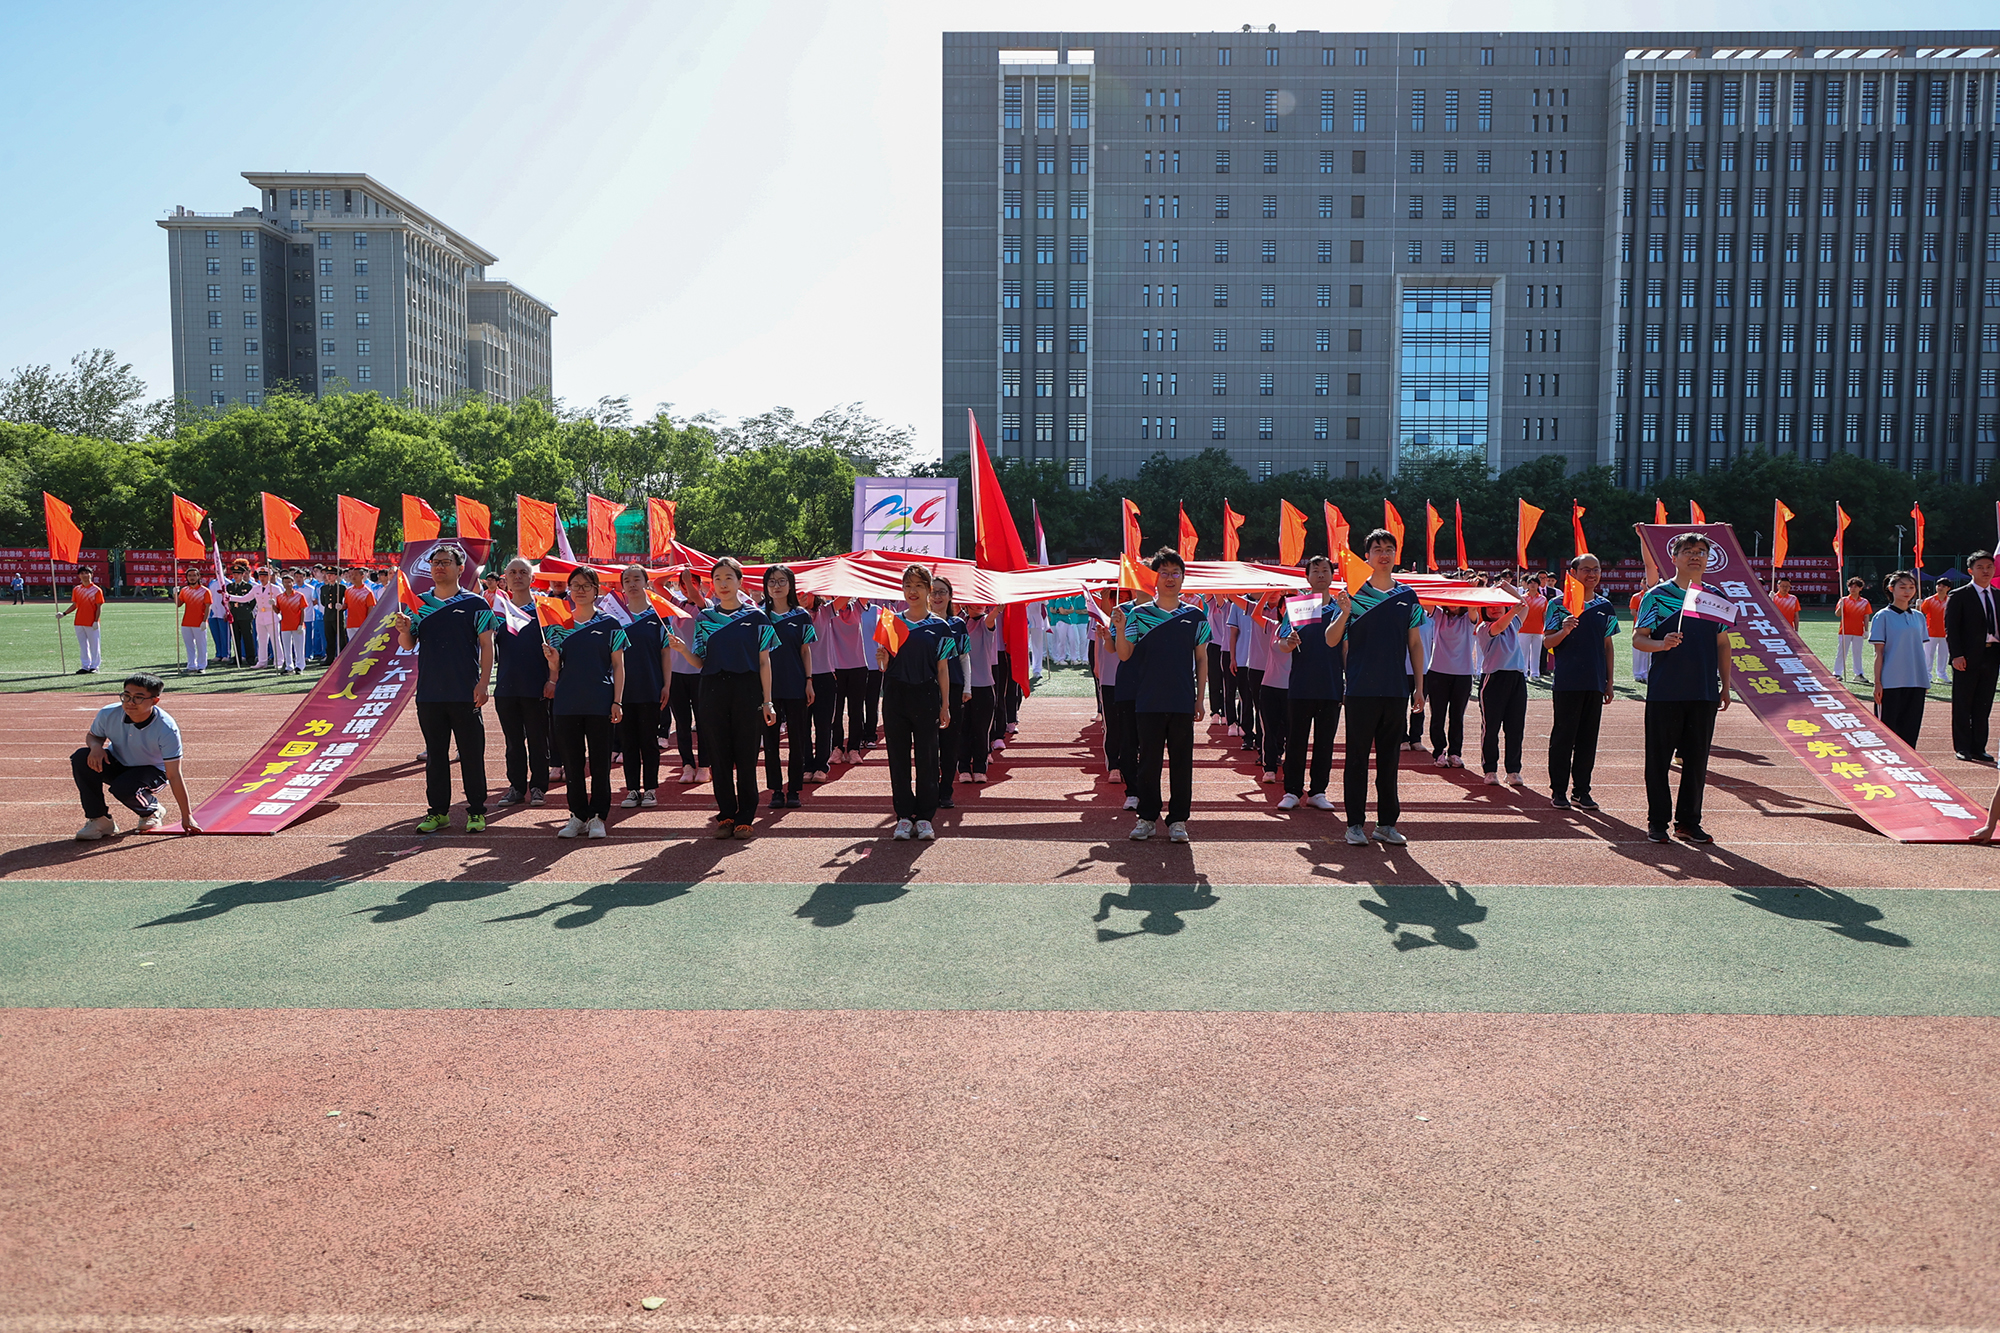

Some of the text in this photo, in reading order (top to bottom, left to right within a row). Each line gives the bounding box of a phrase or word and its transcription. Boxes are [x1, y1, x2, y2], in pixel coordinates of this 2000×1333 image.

[234, 611, 398, 794] 为党育人 为国育才
[1720, 580, 1977, 819] 奋力书写重点马院建设新篇章
[1786, 718, 1896, 800] 争先作为
